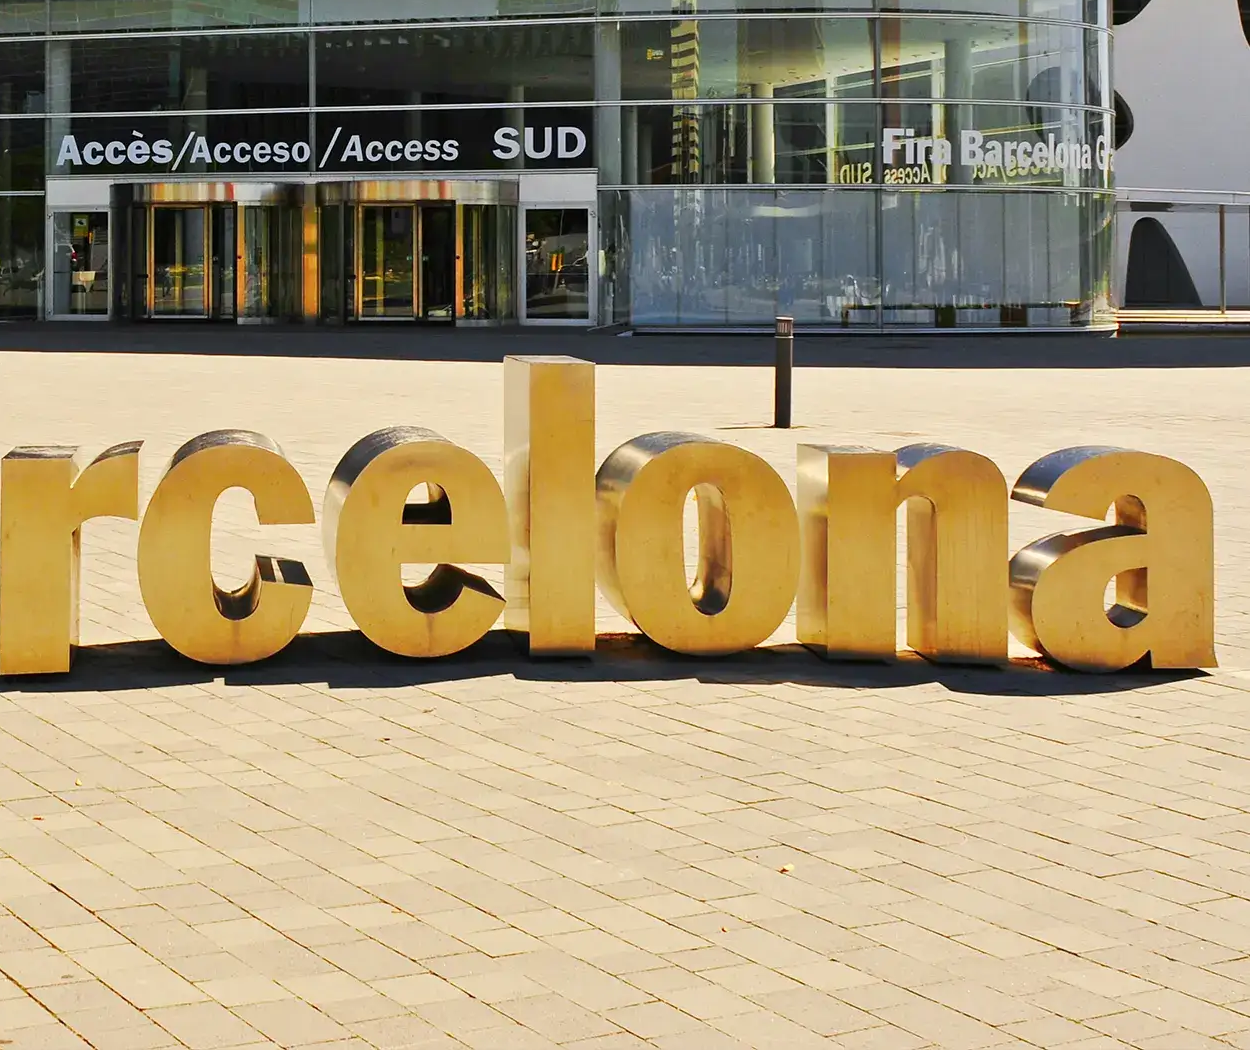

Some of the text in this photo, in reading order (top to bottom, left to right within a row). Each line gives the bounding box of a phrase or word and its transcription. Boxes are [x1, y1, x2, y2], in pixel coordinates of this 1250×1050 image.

[492, 127, 587, 160] SUD
[882, 127, 952, 166] Fira
[960, 129, 1092, 170] Barcelona
